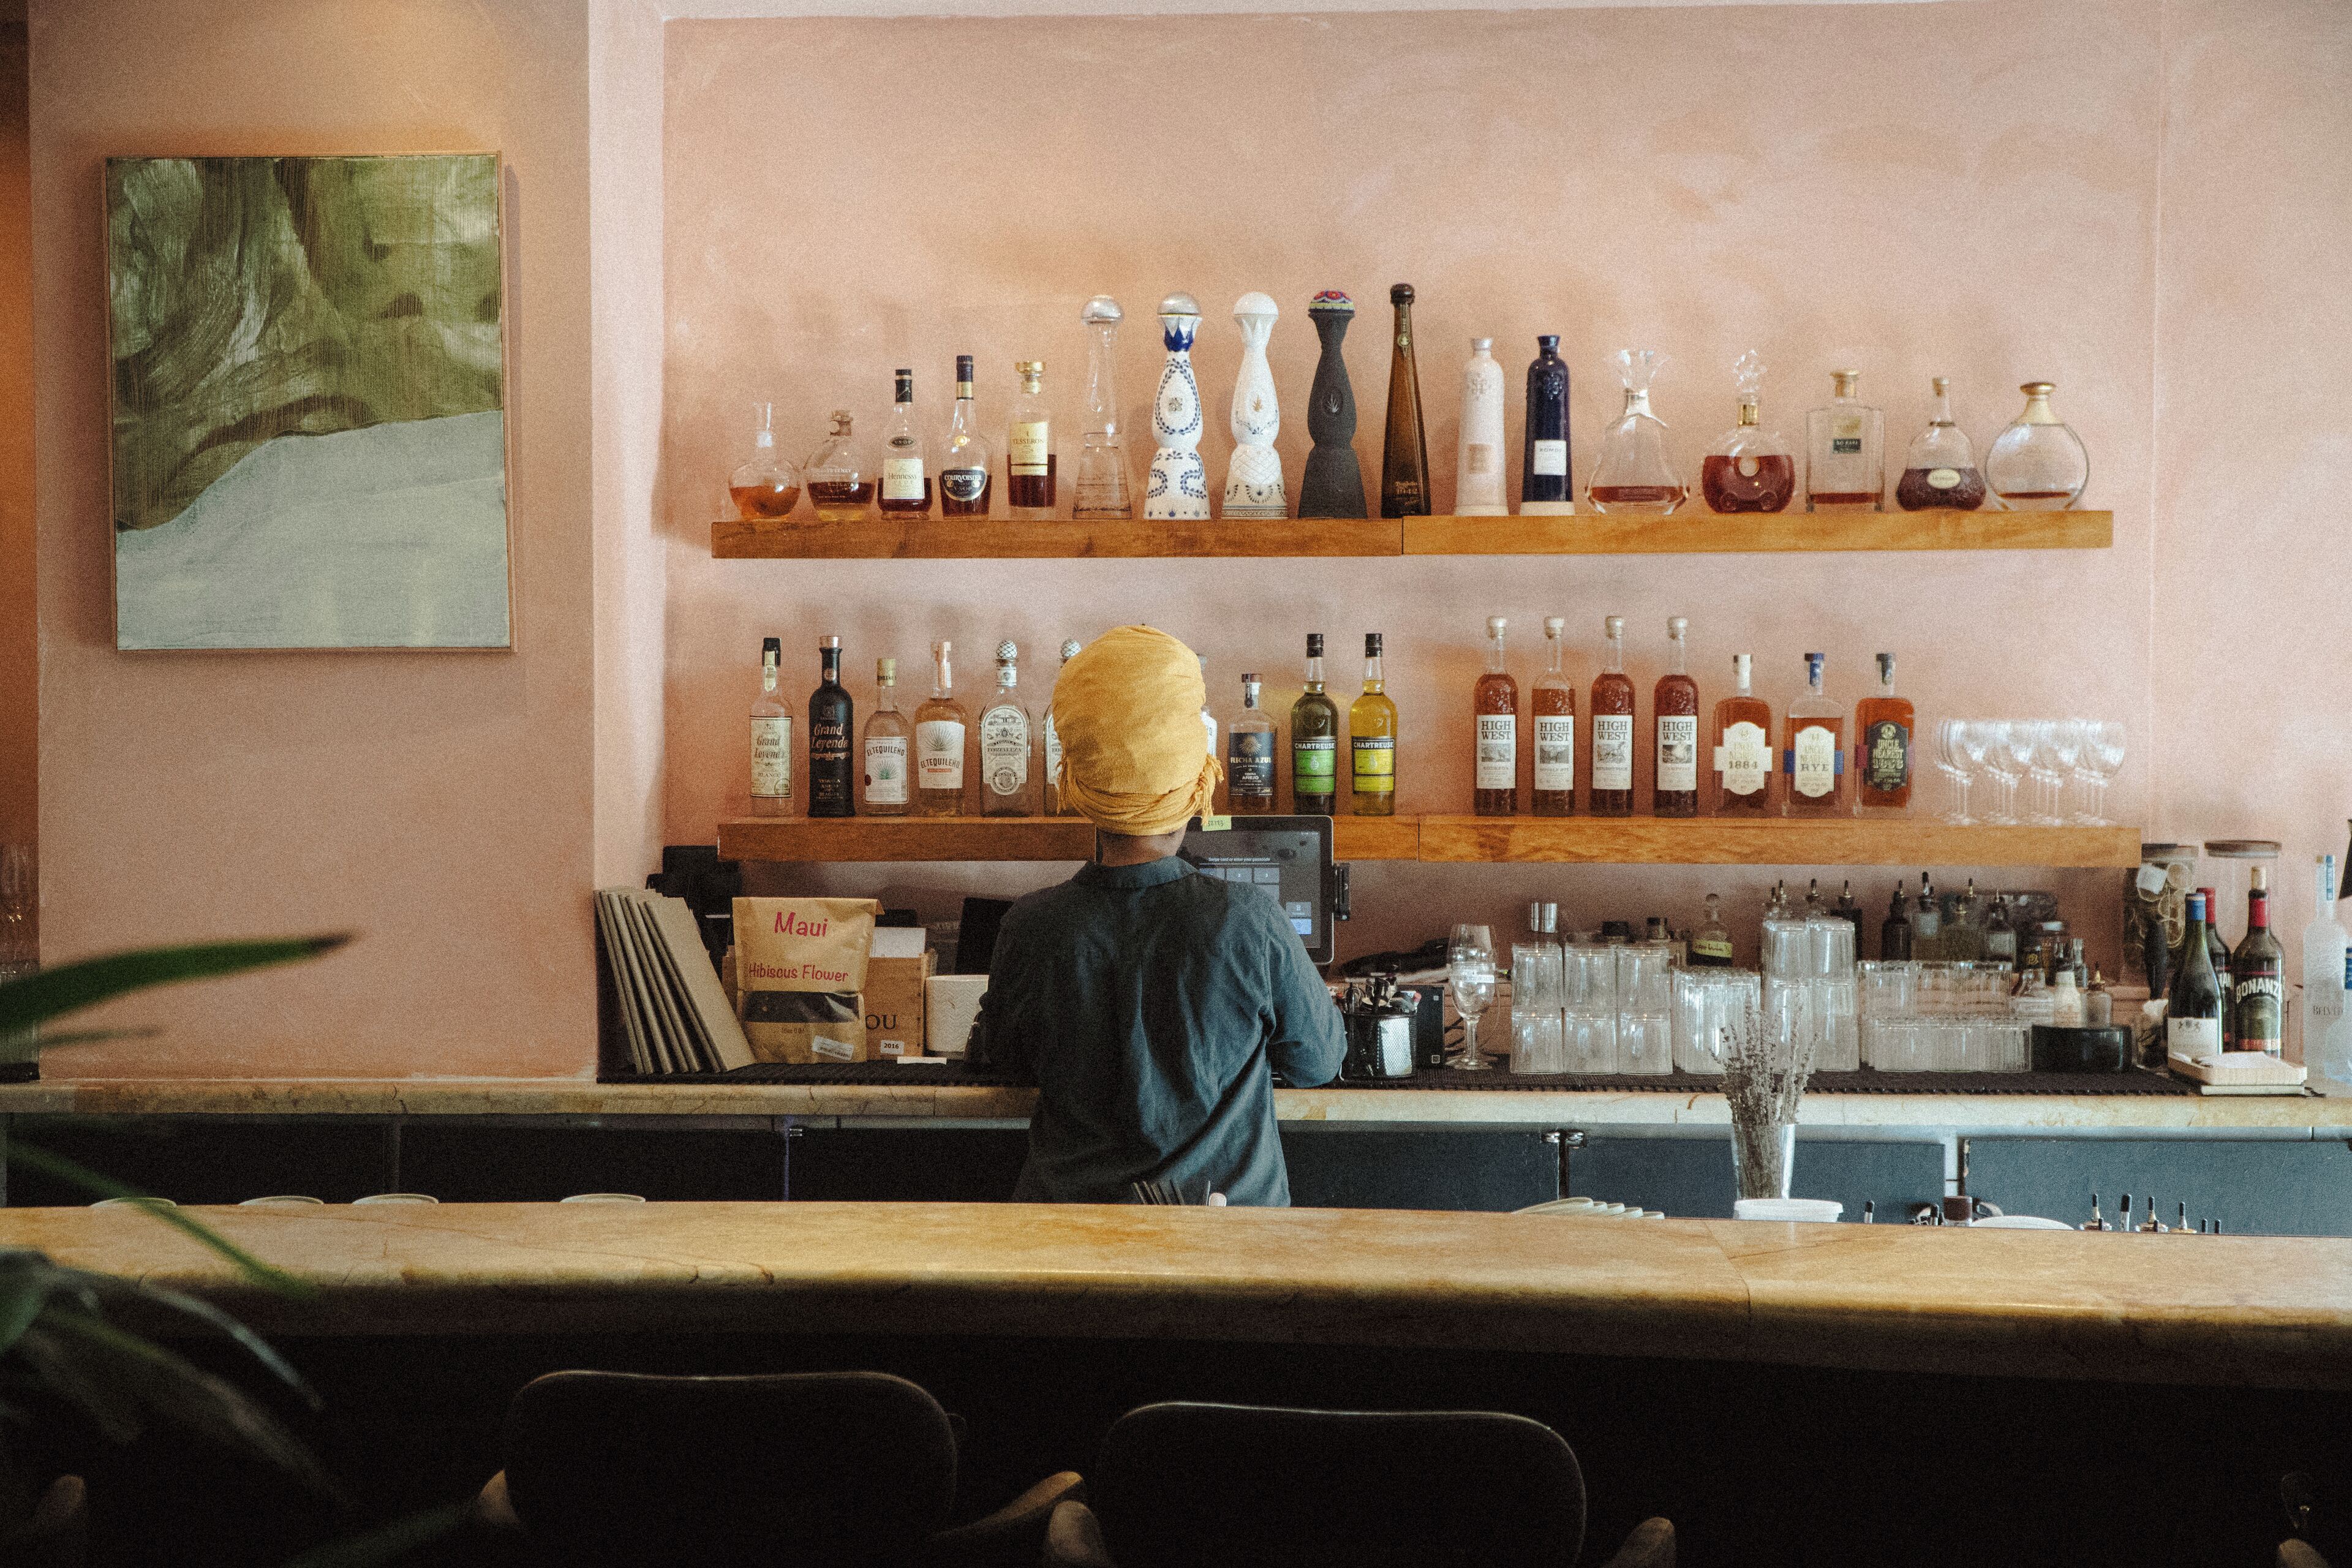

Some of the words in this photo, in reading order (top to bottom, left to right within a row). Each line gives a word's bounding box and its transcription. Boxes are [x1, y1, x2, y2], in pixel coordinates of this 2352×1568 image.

[943, 474, 983, 483] COURVOISIER
[814, 723, 843, 735] Grand
[1481, 720, 1511, 731] HIGH
[1540, 722, 1569, 732] HIGH
[1597, 720, 1627, 731] HIGH
[1662, 722, 1692, 731] HIGH
[756, 735, 780, 746] Grand
[1481, 731, 1511, 741] WEST
[1540, 733, 1569, 742] WEST
[1597, 731, 1627, 741] WEST
[1662, 732, 1692, 741] WEST
[811, 736, 849, 752] Leyenda
[1877, 739, 1900, 749] UNCLE
[1873, 749, 1904, 759] NEAREST
[1728, 761, 1758, 769] 1884
[774, 911, 828, 937] Maui
[748, 962, 798, 979] Hibiscus
[802, 964, 849, 981] Flower
